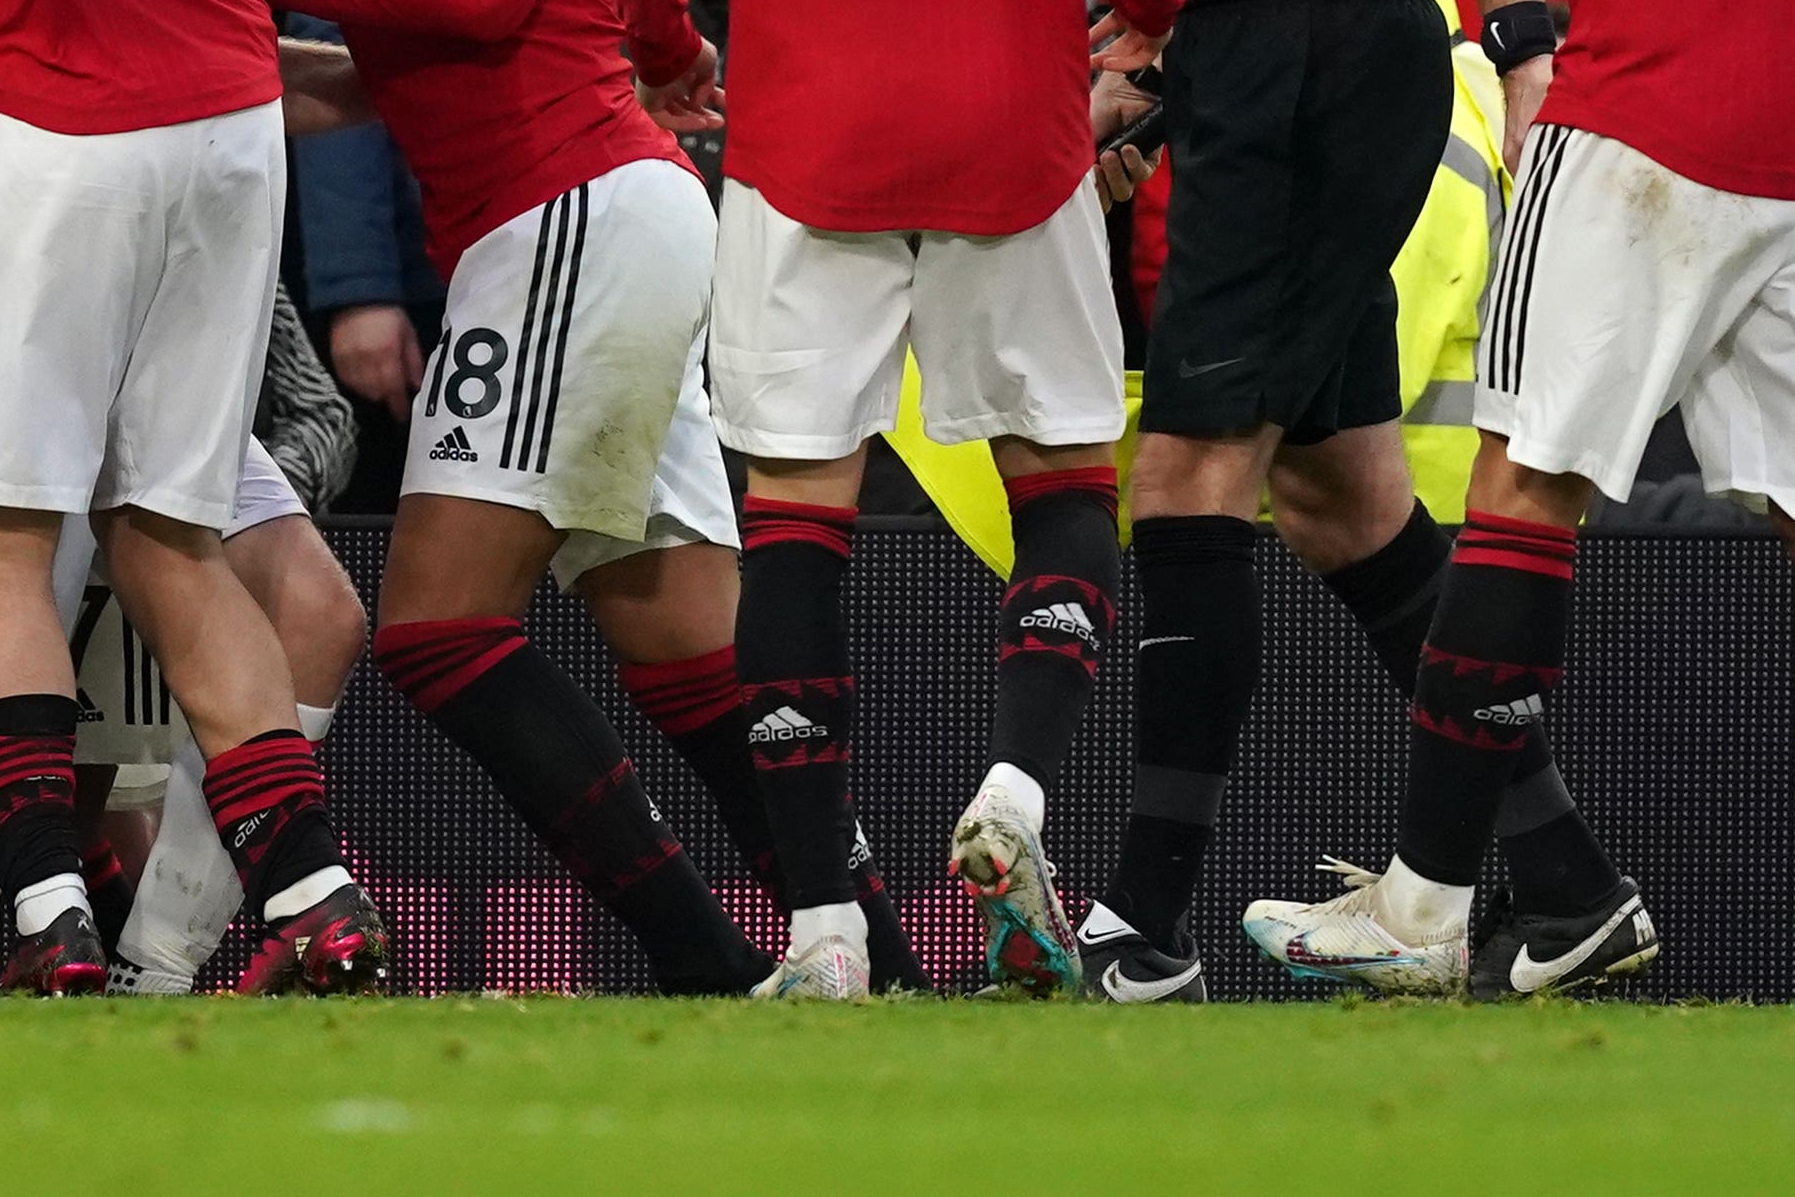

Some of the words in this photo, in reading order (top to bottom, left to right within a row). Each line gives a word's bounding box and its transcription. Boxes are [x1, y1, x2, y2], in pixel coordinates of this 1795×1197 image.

[425, 327, 509, 419] 18
[429, 449, 478, 462] adidas
[748, 724, 829, 744] adidas
